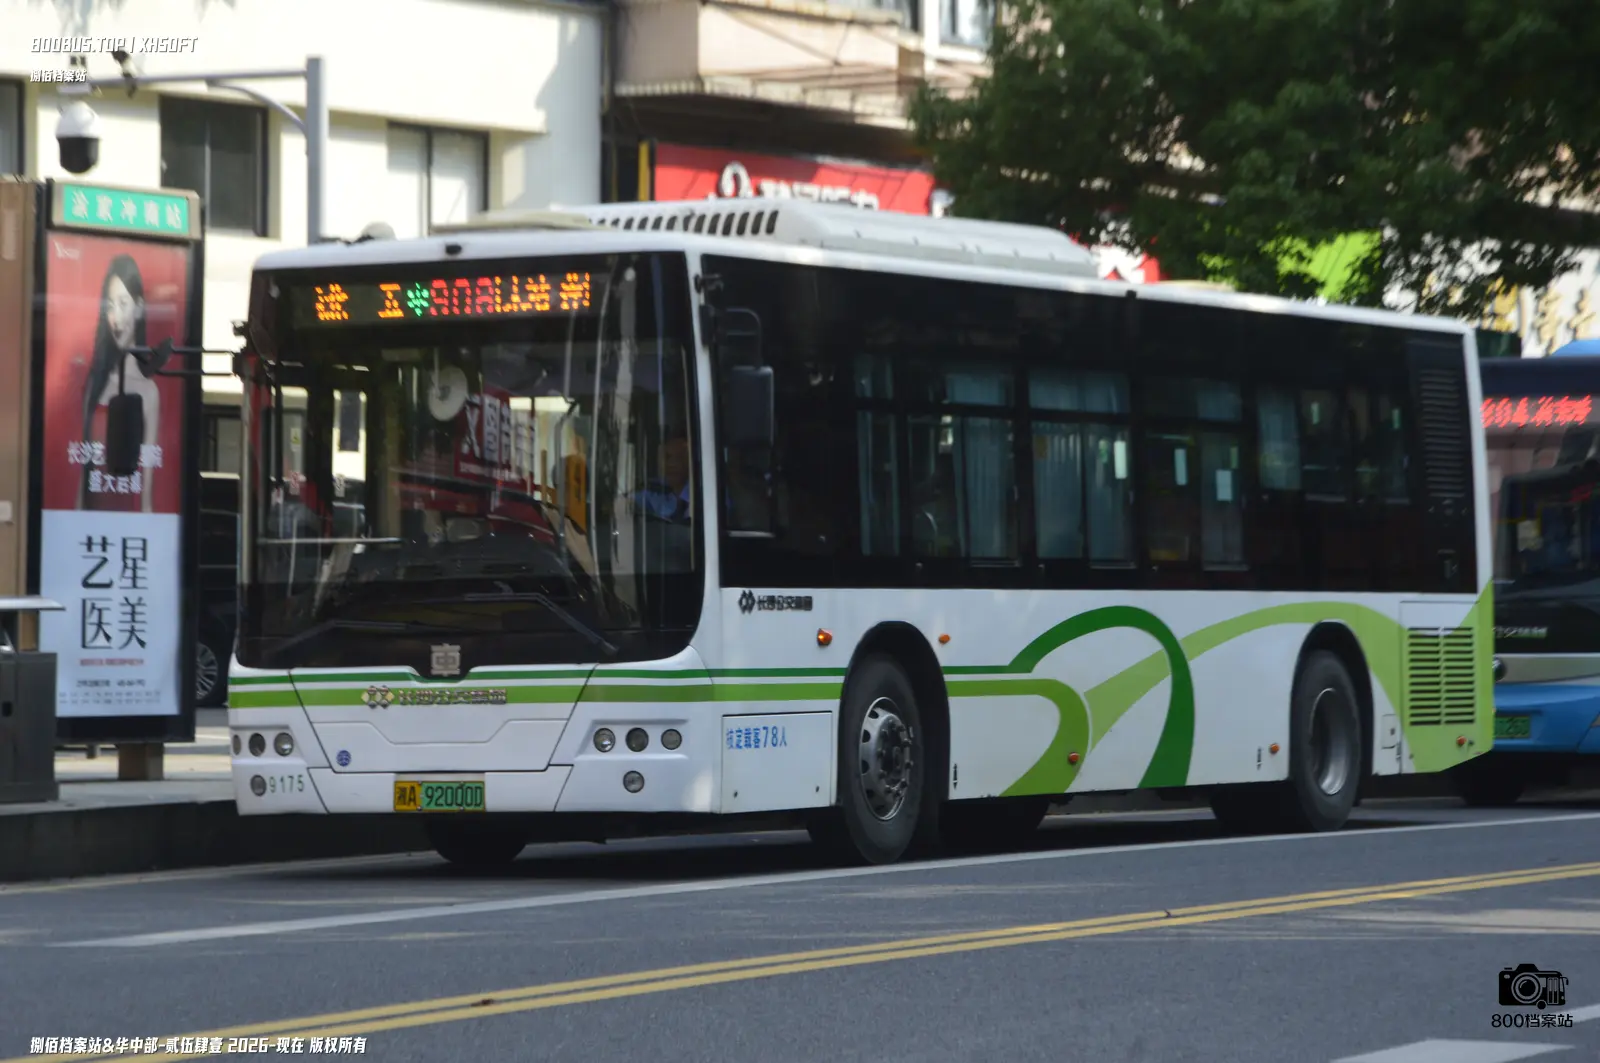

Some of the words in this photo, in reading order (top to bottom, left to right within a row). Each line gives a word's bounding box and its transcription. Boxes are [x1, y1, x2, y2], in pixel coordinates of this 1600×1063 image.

[79, 534, 148, 590] 艺星
[80, 596, 148, 650] 医美
[269, 774, 305, 794] 9175
